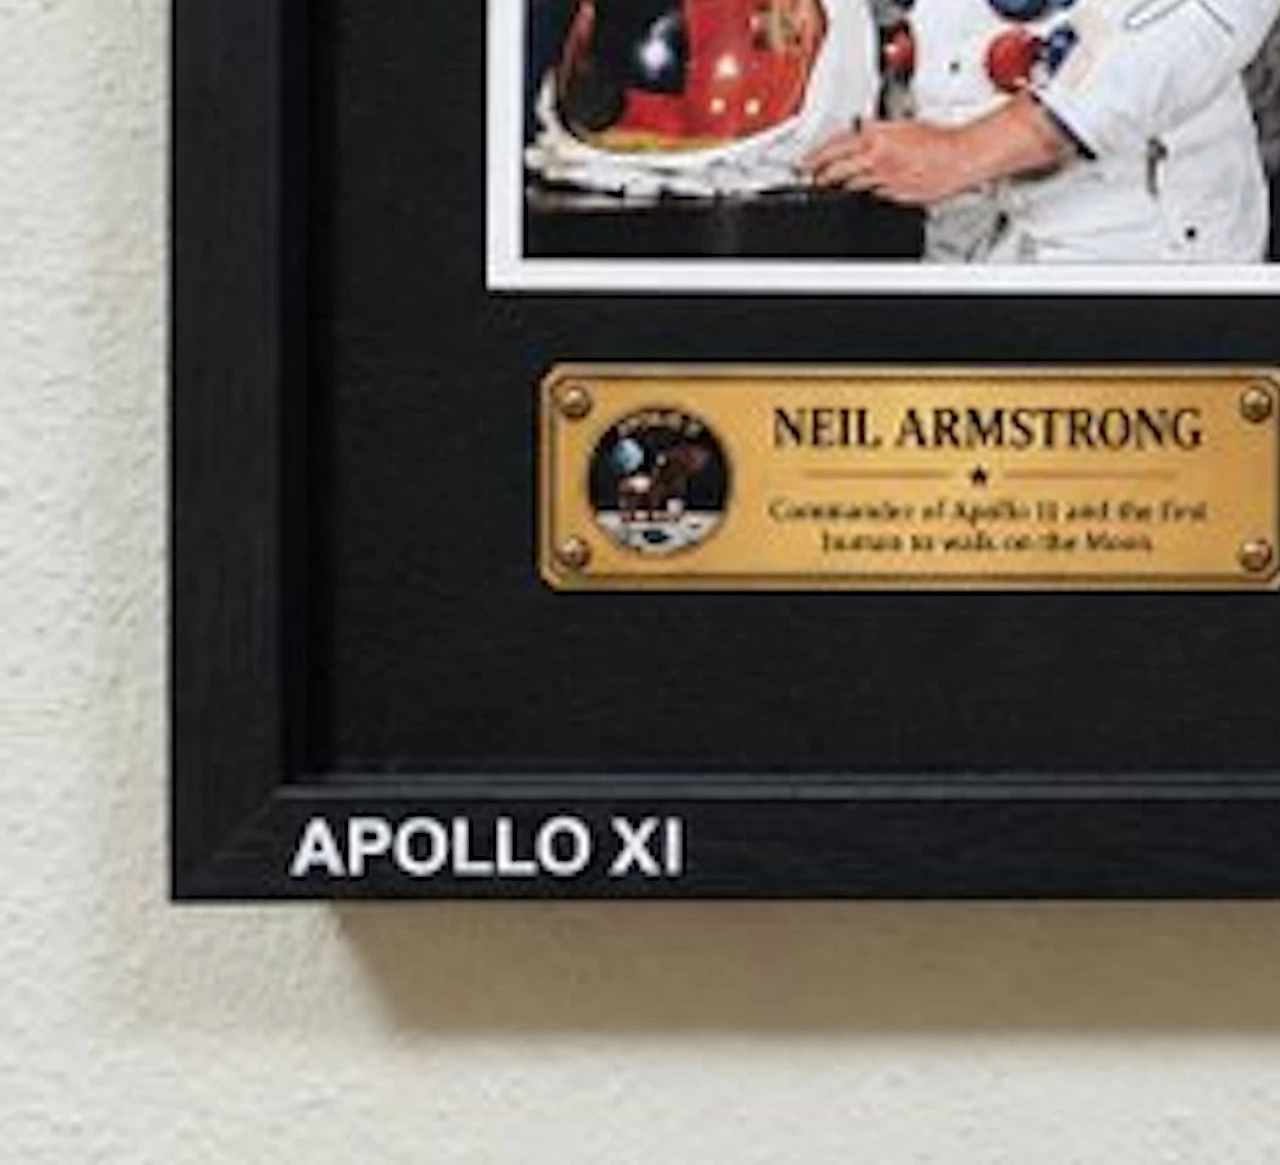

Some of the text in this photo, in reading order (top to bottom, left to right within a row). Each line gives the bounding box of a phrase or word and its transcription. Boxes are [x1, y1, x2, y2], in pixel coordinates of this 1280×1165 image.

[774, 407, 1203, 451] NEIL ARMSTRONG
[768, 497, 916, 523] Commander
[954, 499, 1031, 528] Apollo
[1065, 499, 1110, 522] and
[291, 815, 684, 877] APOLLO XI
